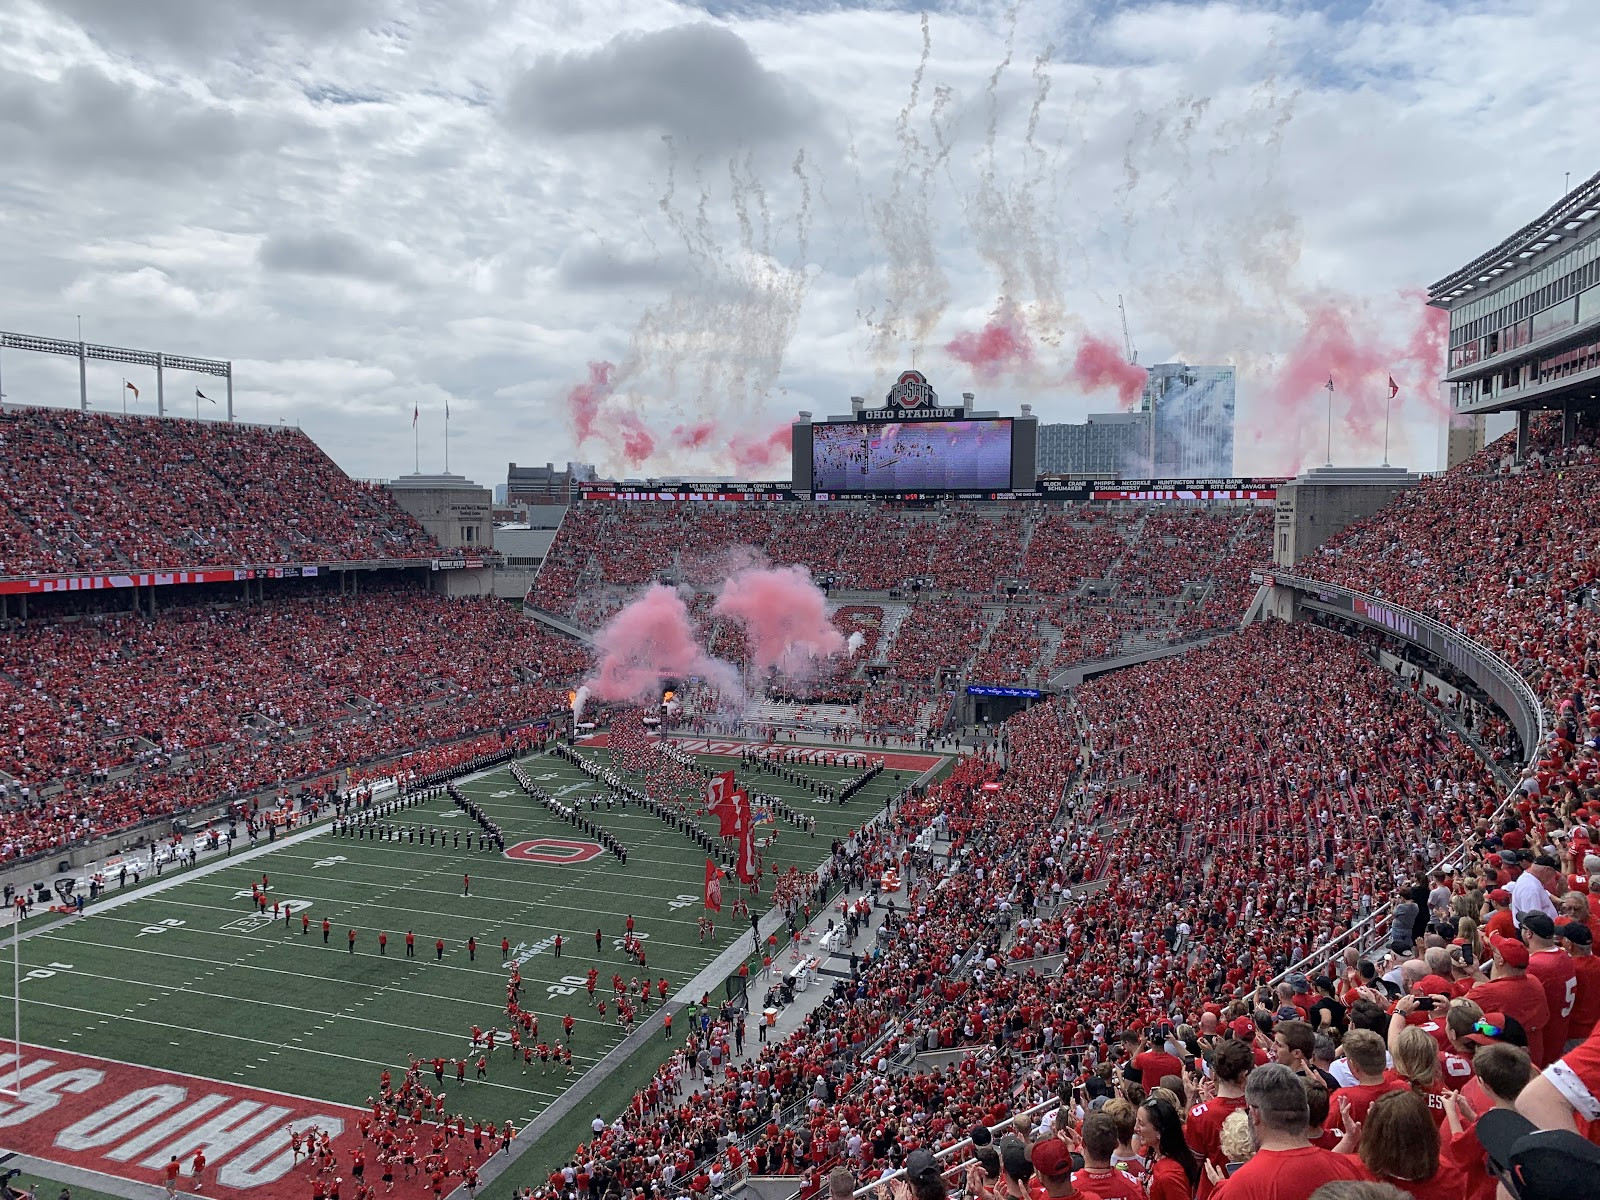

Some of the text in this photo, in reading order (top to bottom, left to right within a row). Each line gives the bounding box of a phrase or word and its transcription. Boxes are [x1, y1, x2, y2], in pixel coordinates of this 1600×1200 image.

[865, 408, 956, 420] OHIO STADIUM
[547, 975, 590, 996] 20
[1561, 976, 1577, 1018] 5
[53, 1083, 346, 1191] OHIO
